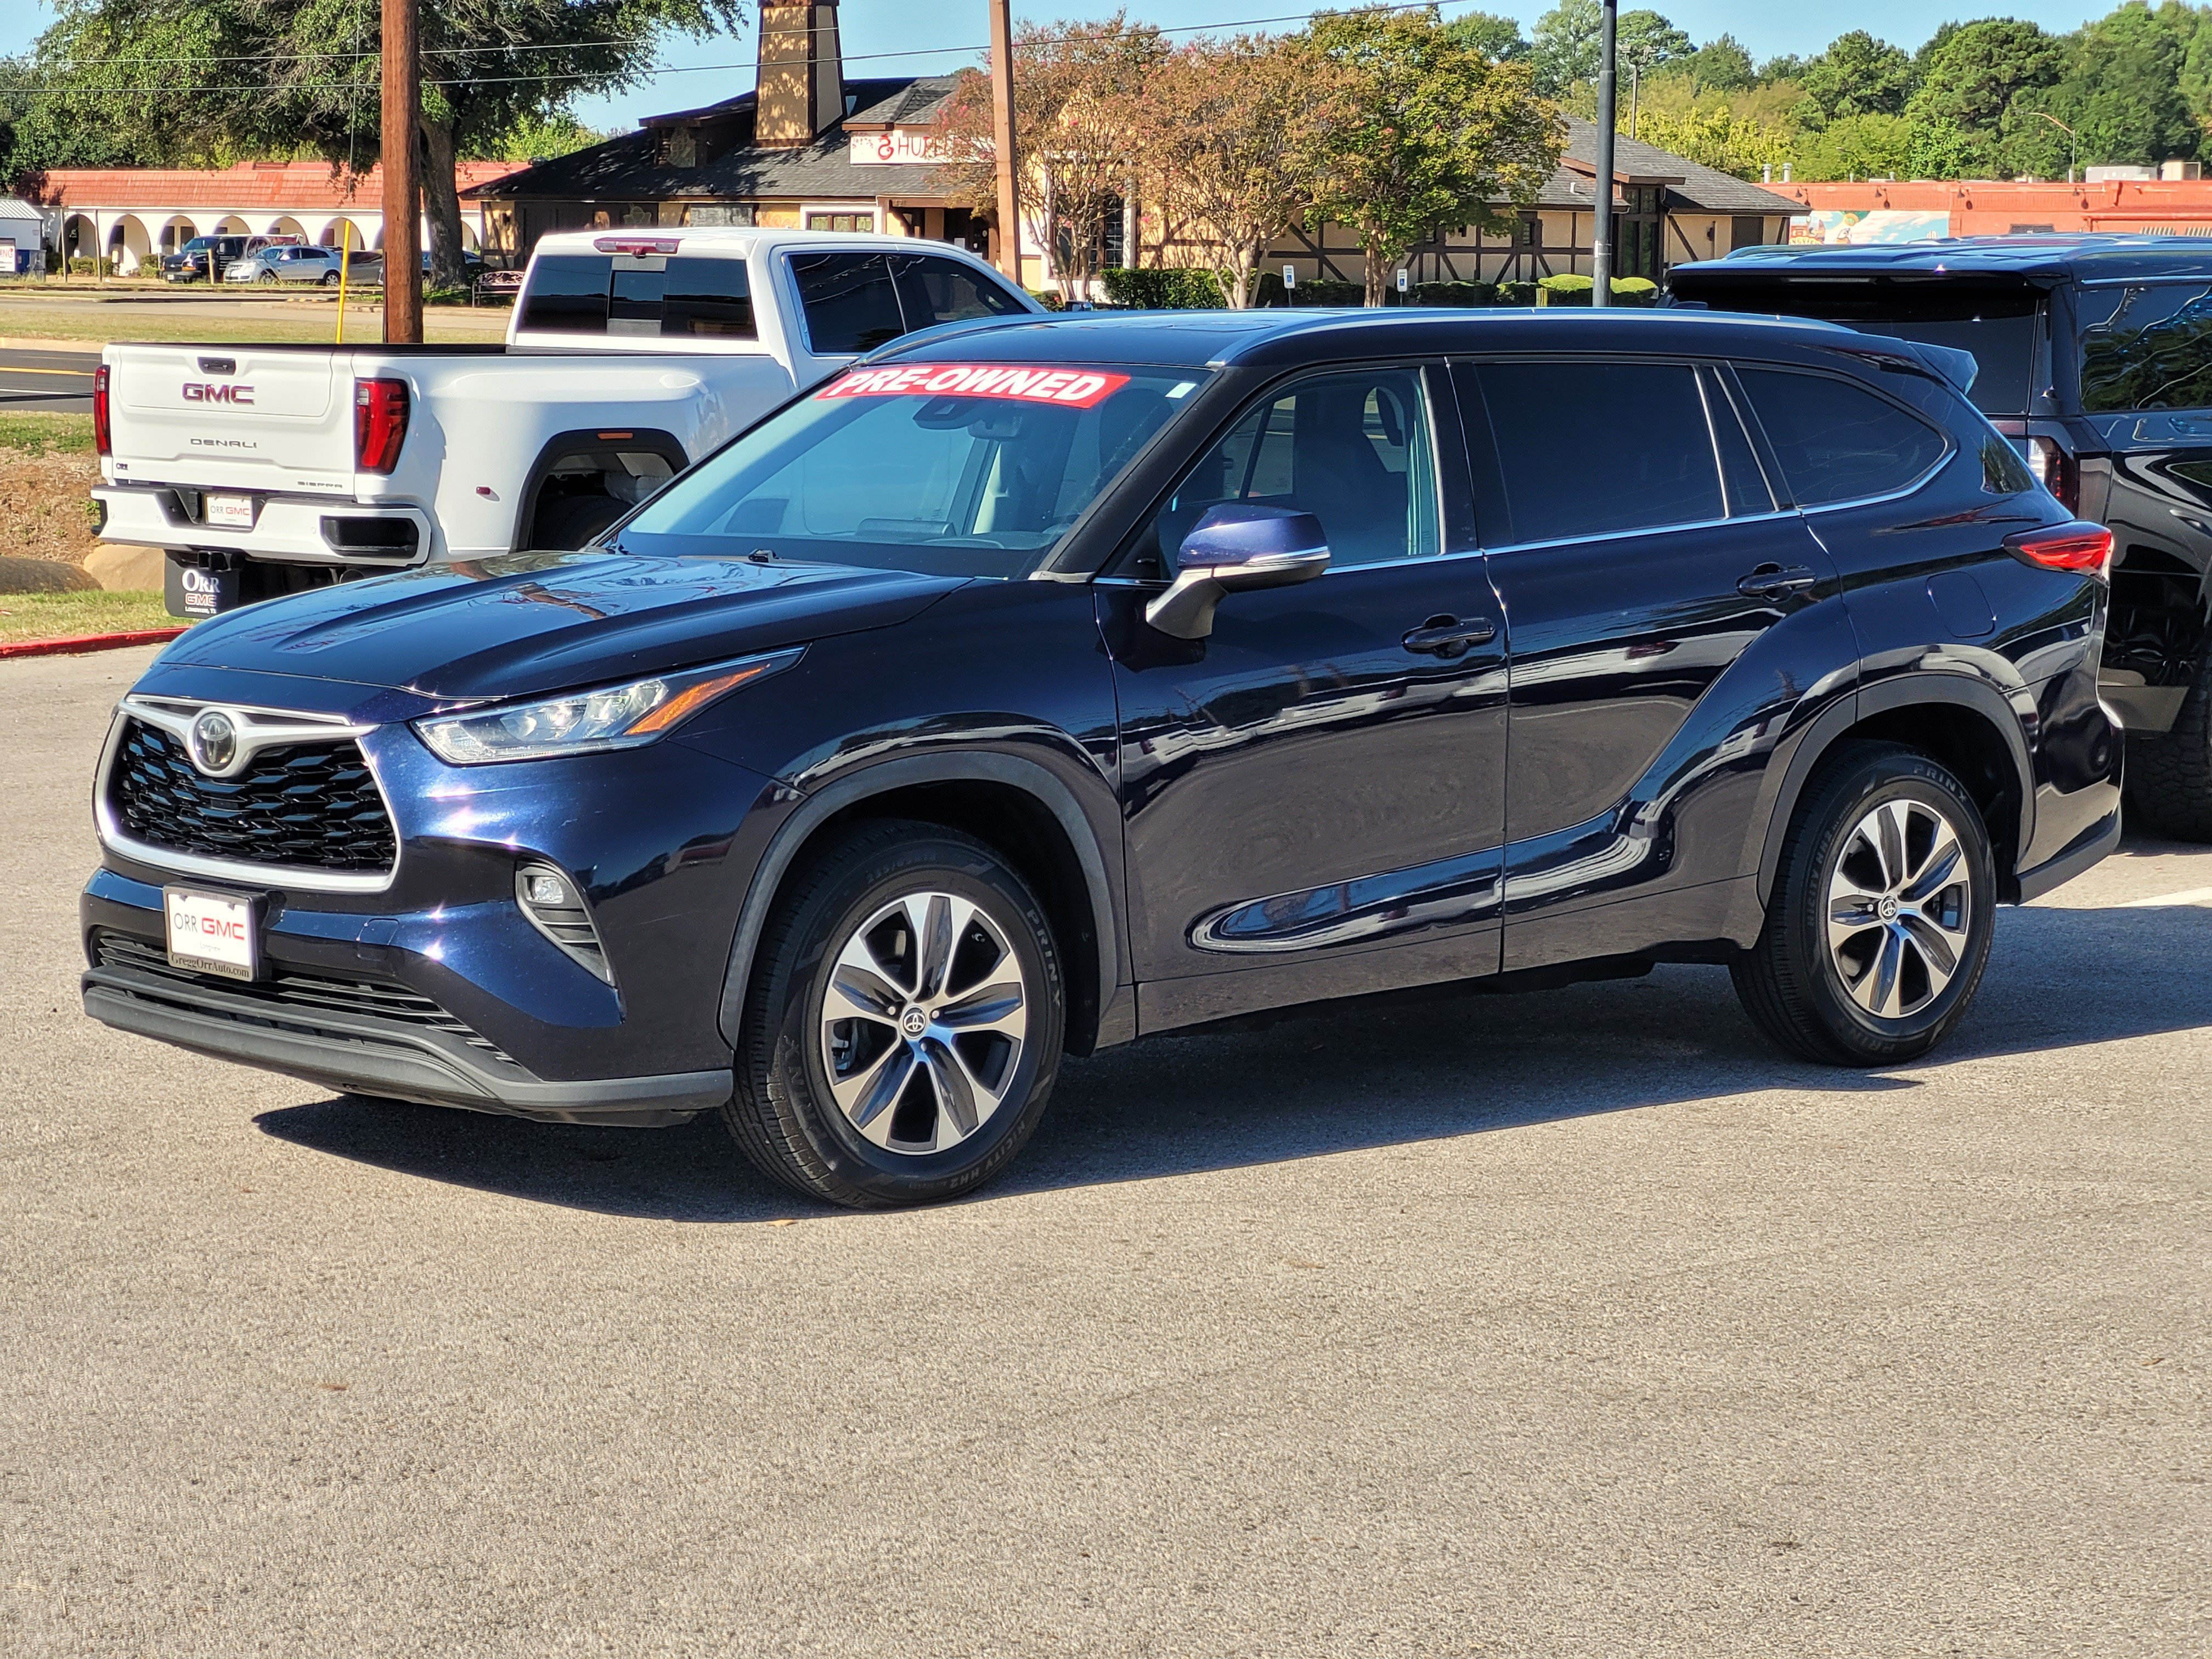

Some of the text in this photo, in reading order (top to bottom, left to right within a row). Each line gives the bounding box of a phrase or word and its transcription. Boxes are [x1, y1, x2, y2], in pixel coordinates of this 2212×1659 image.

[183, 382, 255, 405] GMC
[826, 367, 1106, 401] PRE-OWNED
[190, 438, 257, 448] DENALI
[210, 505, 250, 516] ORR GMC
[185, 593, 217, 607] GMC
[1913, 763, 1967, 803] PRINX
[174, 912, 245, 940] ORR GMC
[171, 953, 249, 978] GreggOrrAuto.com
[1026, 908, 1061, 1007] PRINX
[1839, 1020, 1896, 1054] PRIN
